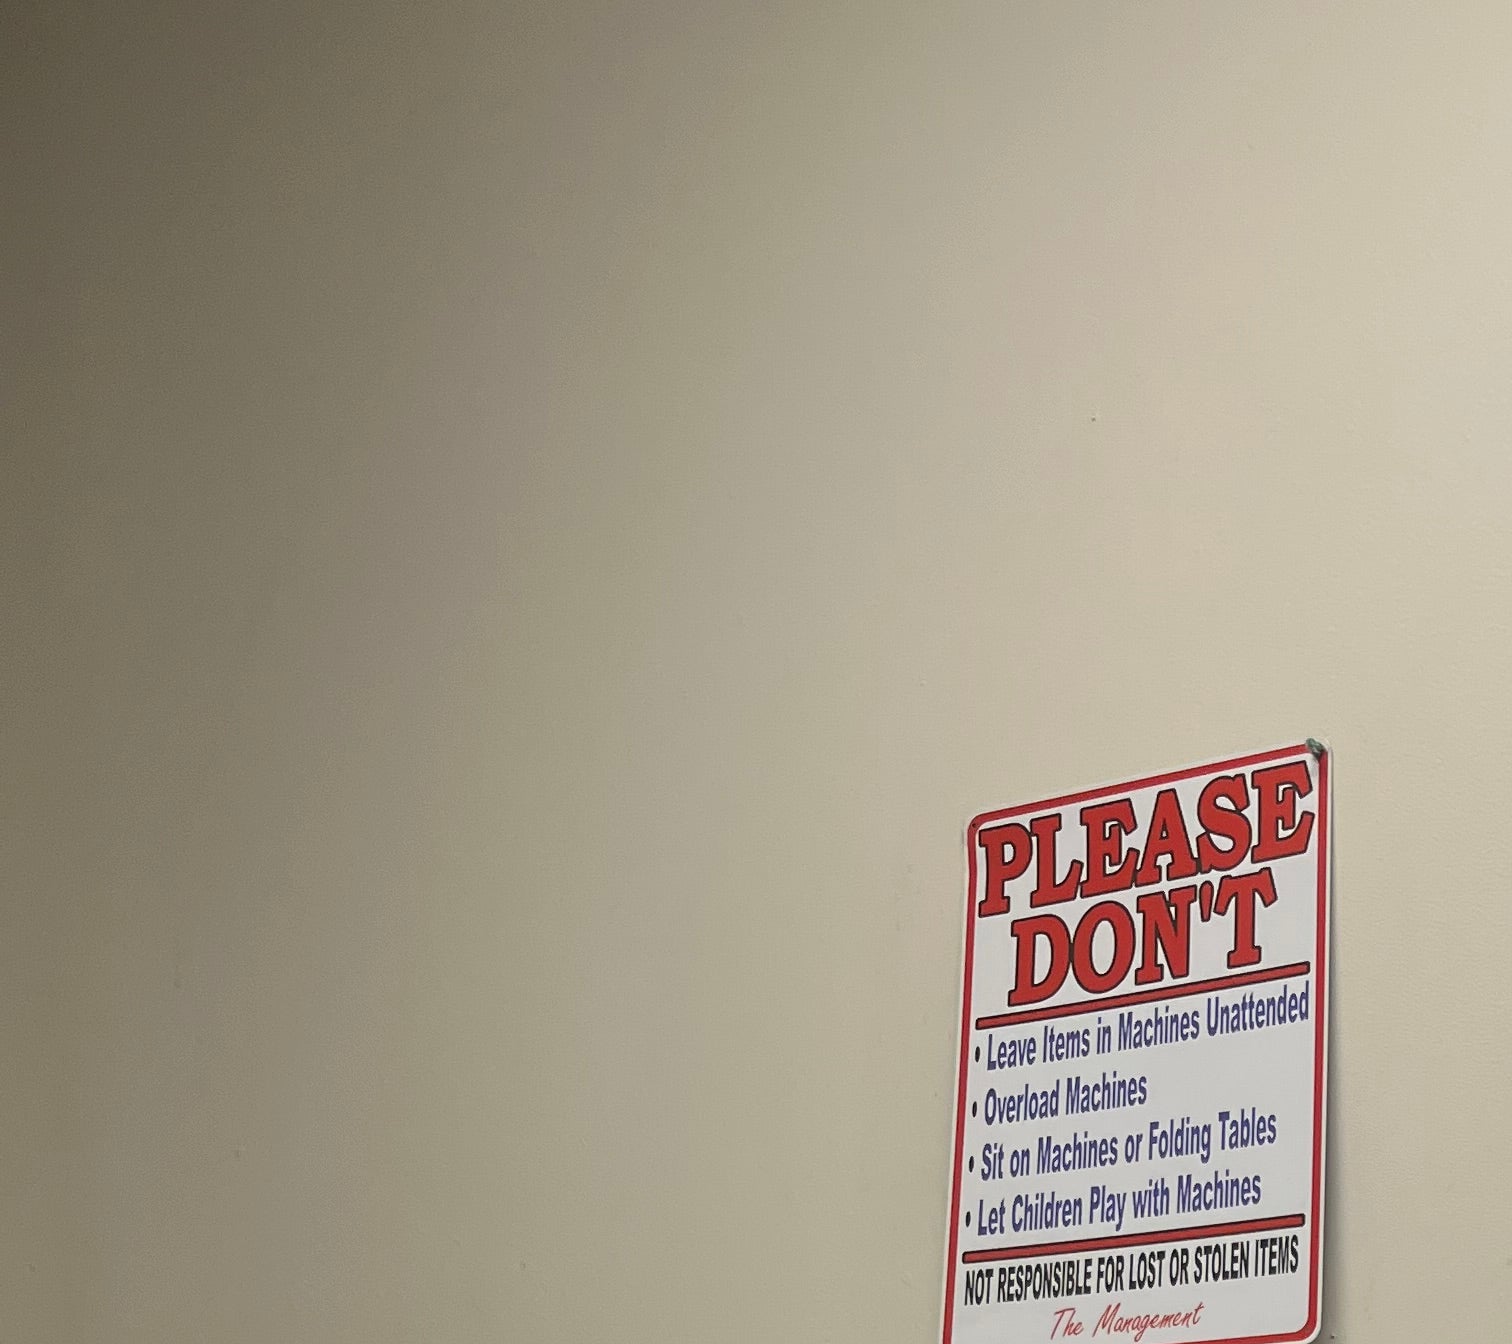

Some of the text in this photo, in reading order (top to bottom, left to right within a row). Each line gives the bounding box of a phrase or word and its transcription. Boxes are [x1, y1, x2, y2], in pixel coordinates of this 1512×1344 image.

[979, 760, 1315, 918] PLEASE
[1008, 868, 1277, 1007] DON'T
[987, 980, 1310, 1071] Leave Items in Machines Unattended
[984, 1071, 1147, 1125] Overload Machines
[981, 1107, 1277, 1181] Sit on Machines or Folding Tables
[977, 1170, 1261, 1236] Let Children Play with Machines
[964, 1234, 1299, 1306] NOT RESPONSIBLE FOR LOST OR STOLEN ITEMS
[1050, 1301, 1205, 1342] The Management
